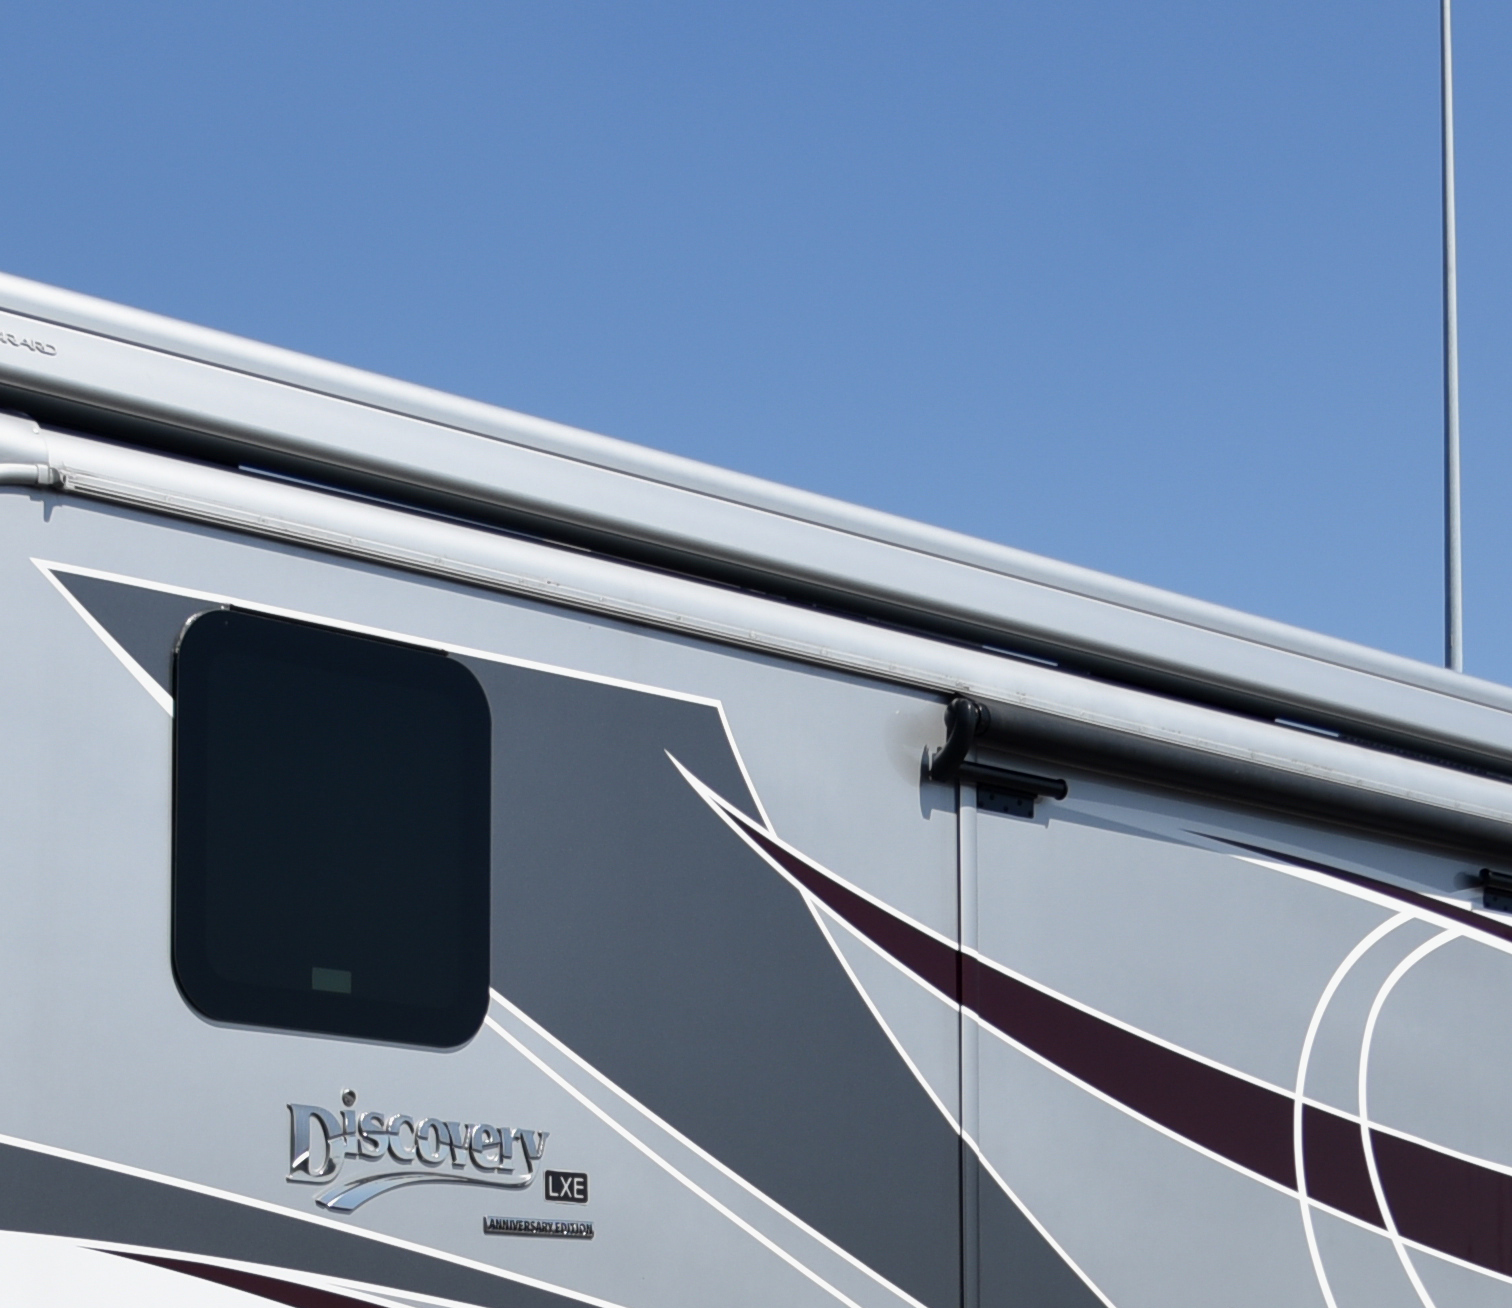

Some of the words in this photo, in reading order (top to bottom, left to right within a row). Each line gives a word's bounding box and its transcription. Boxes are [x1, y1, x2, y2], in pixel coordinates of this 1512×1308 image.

[285, 1086, 551, 1194] Discovery
[548, 1176, 585, 1200] LXE
[487, 1217, 554, 1235] ANNIVERSARY
[554, 1221, 593, 1236] EDITION
